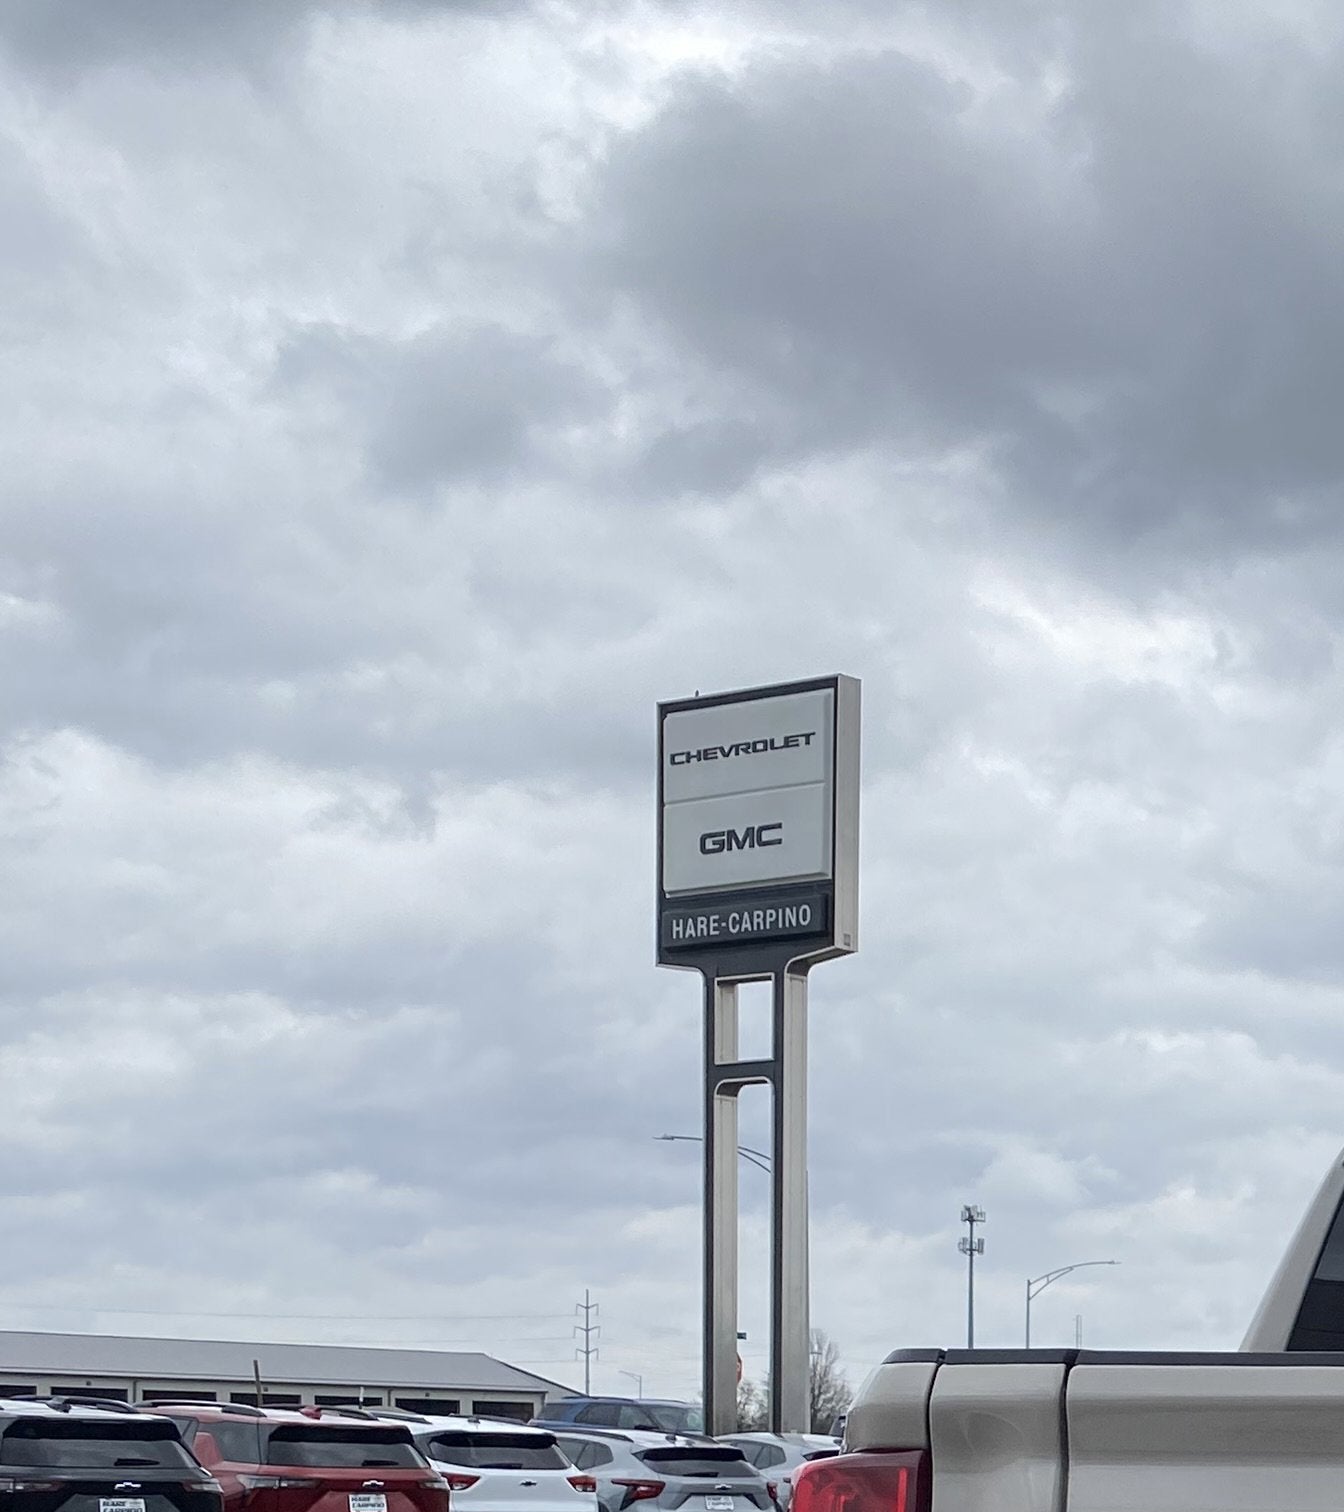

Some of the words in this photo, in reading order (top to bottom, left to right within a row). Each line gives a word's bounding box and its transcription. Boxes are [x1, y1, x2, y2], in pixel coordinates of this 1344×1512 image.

[669, 731, 816, 766] CHEVROLET
[699, 822, 783, 855] GMC
[671, 903, 812, 940] HARE-CARPINO
